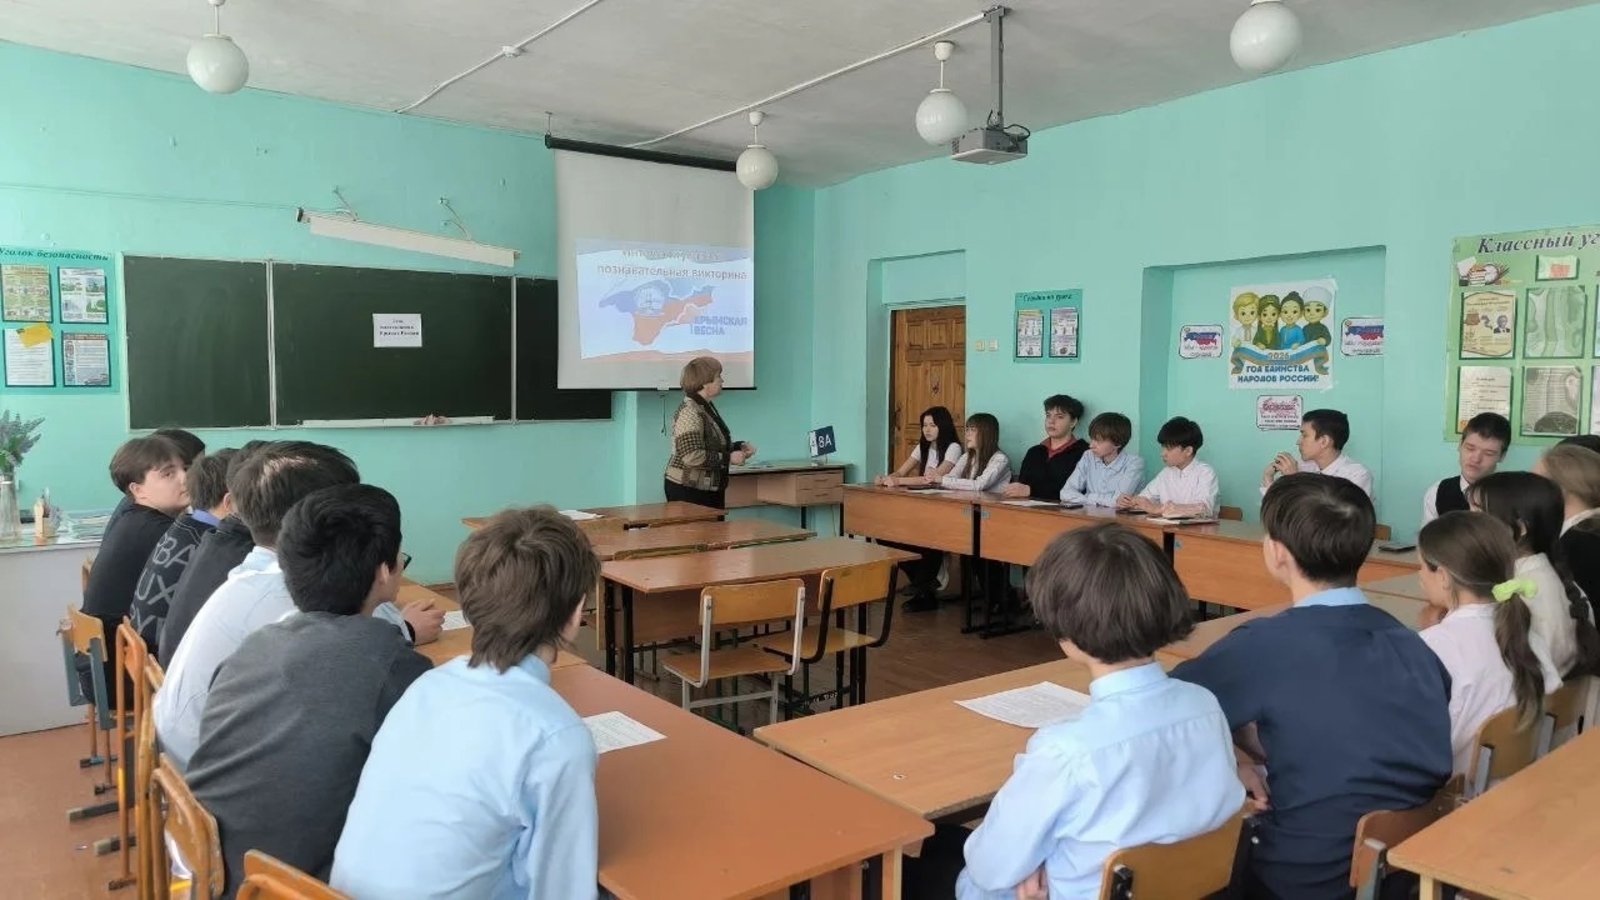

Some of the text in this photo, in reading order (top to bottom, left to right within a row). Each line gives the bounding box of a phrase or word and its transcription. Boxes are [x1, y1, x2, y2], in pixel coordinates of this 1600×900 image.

[1478, 231, 1574, 253] Классный
[37, 250, 109, 261] безопасности
[597, 265, 747, 280] познавательная викторина
[694, 316, 748, 326] КРЫМСКАЯ
[694, 326, 725, 335] ВЕСНА
[1246, 365, 1309, 373] ГОД ЕДИНСТВА
